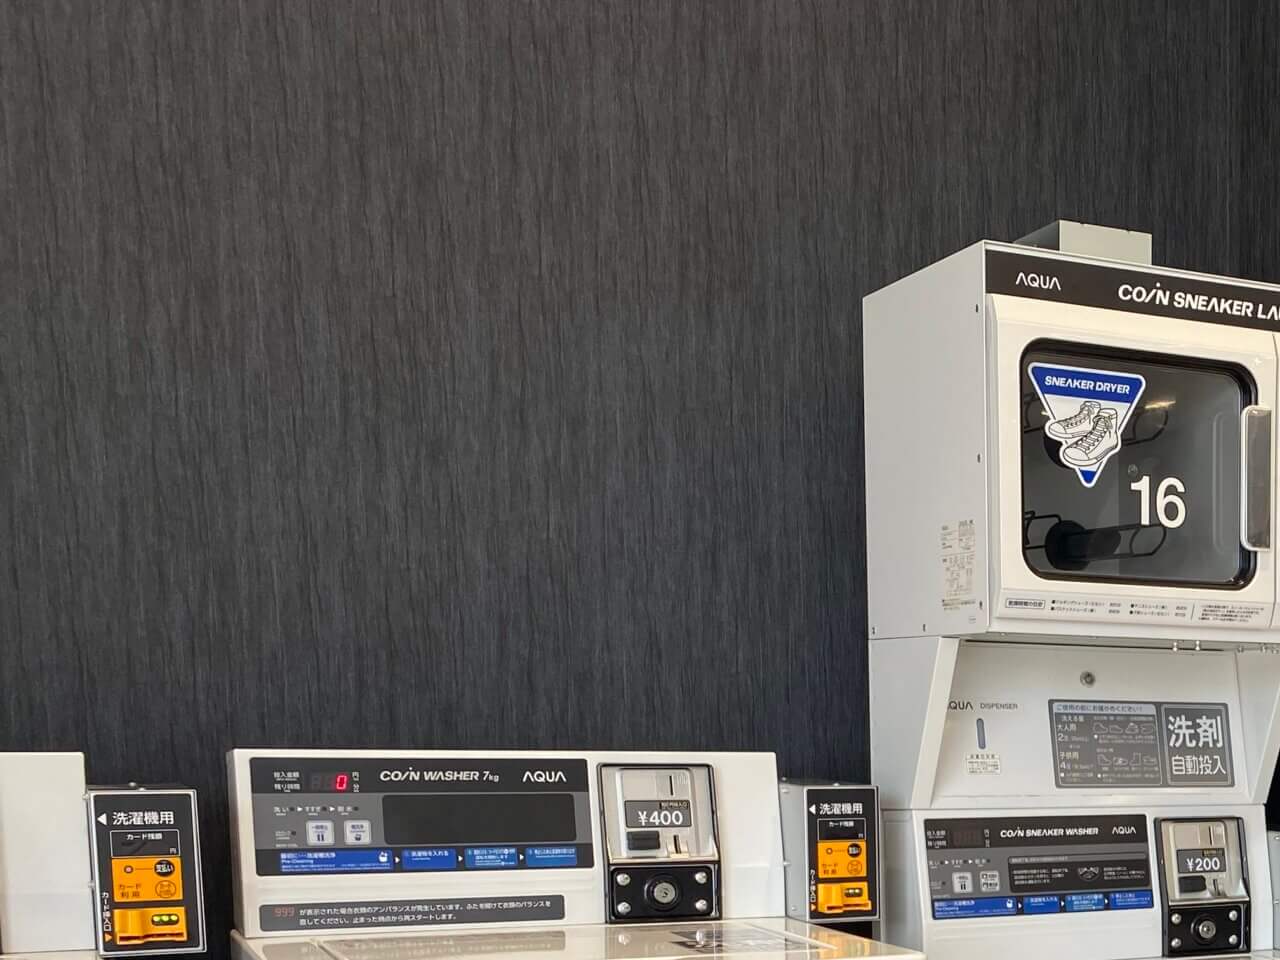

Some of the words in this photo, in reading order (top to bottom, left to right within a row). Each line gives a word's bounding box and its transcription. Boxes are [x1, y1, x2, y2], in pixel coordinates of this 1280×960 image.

[1016, 271, 1061, 291] AQUA
[1173, 292, 1254, 317] SNEAKER
[1045, 375, 1094, 391] SNEAKER
[1095, 382, 1130, 395] DRYER
[1130, 475, 1187, 529] 16
[947, 700, 973, 710] QUA
[1167, 714, 1225, 749] 洗剤
[1171, 754, 1227, 775] 自動投入
[336, 774, 348, 791] 0
[424, 770, 479, 781] WASHER
[482, 770, 500, 783] 7kg
[522, 770, 567, 783] AQUA
[819, 802, 863, 815] 洗濯機用
[112, 811, 175, 826] 洗濯機用
[637, 809, 684, 826] ¥400
[1025, 827, 1064, 838] SNEAKER
[1065, 826, 1099, 837] WASHER
[1111, 826, 1137, 835] AQUA
[1186, 857, 1221, 872] ¥200
